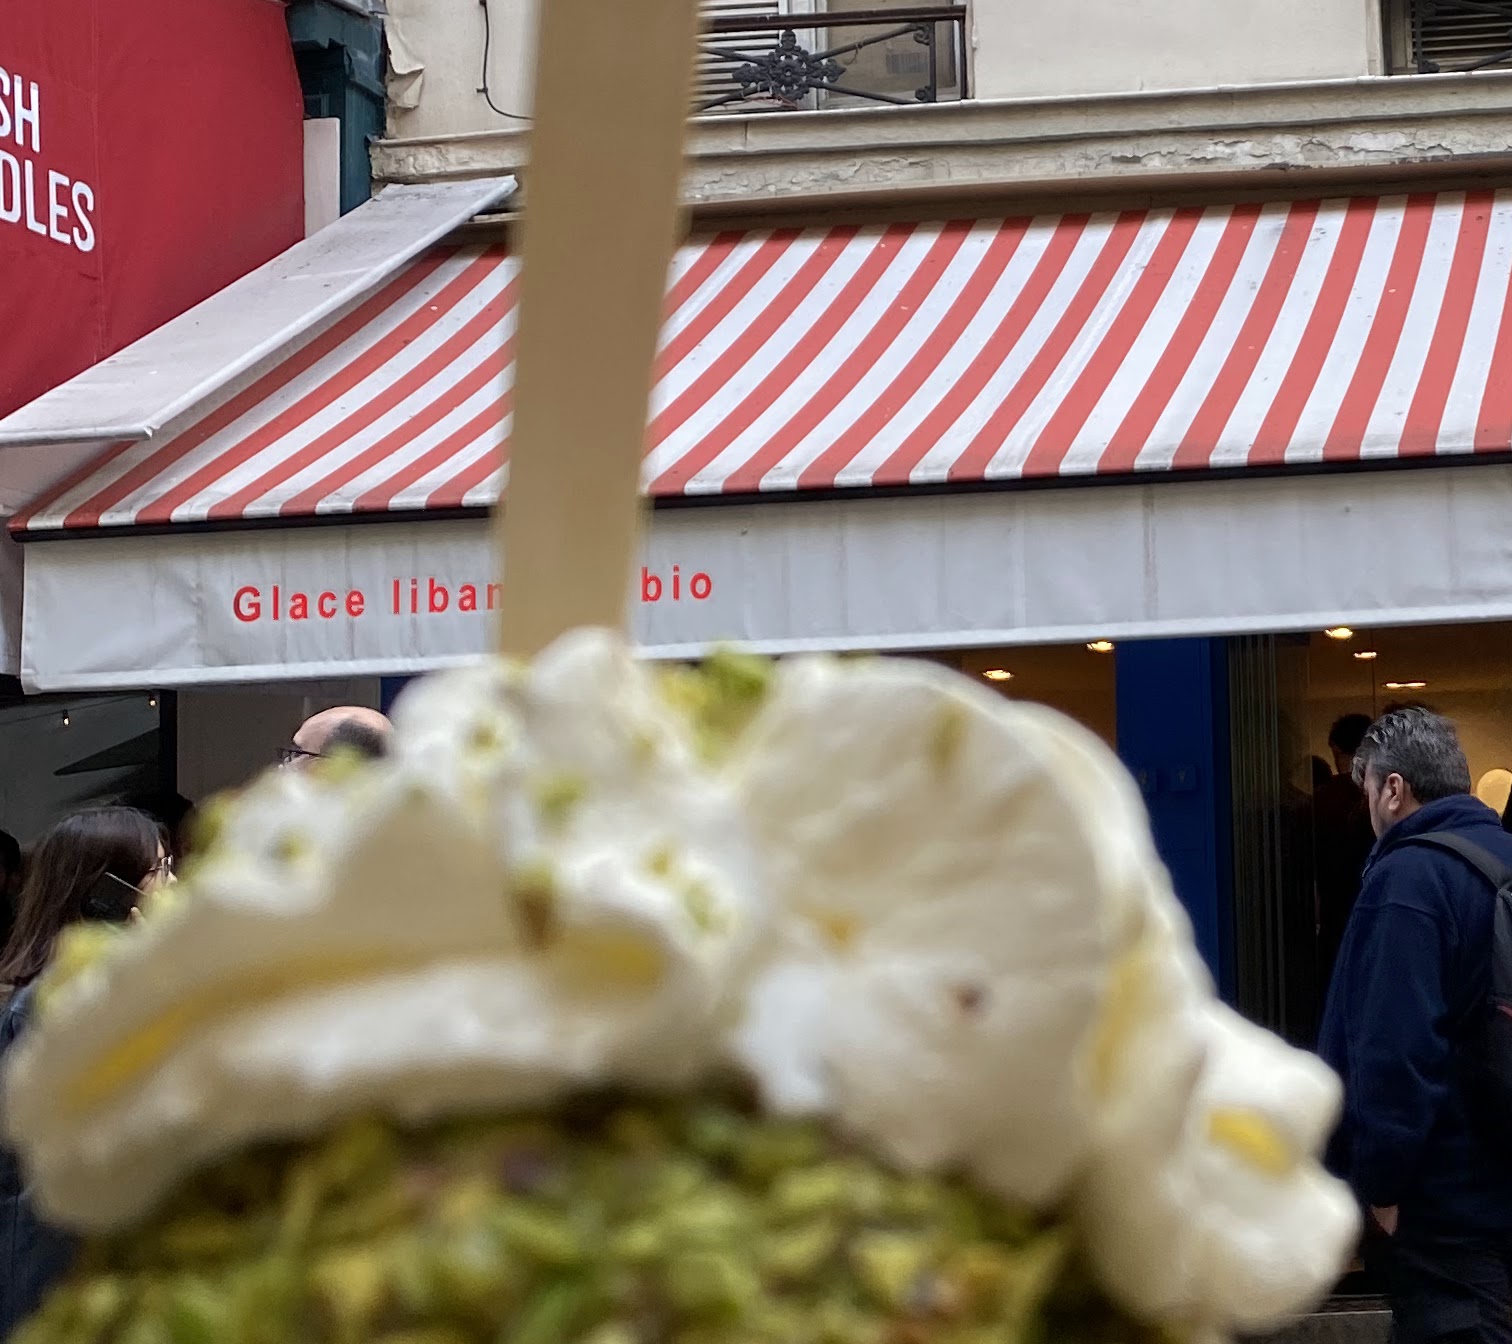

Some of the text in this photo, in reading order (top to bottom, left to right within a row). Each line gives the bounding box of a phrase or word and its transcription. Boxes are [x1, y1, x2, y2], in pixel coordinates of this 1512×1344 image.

[233, 564, 713, 623] Glace liban bio
